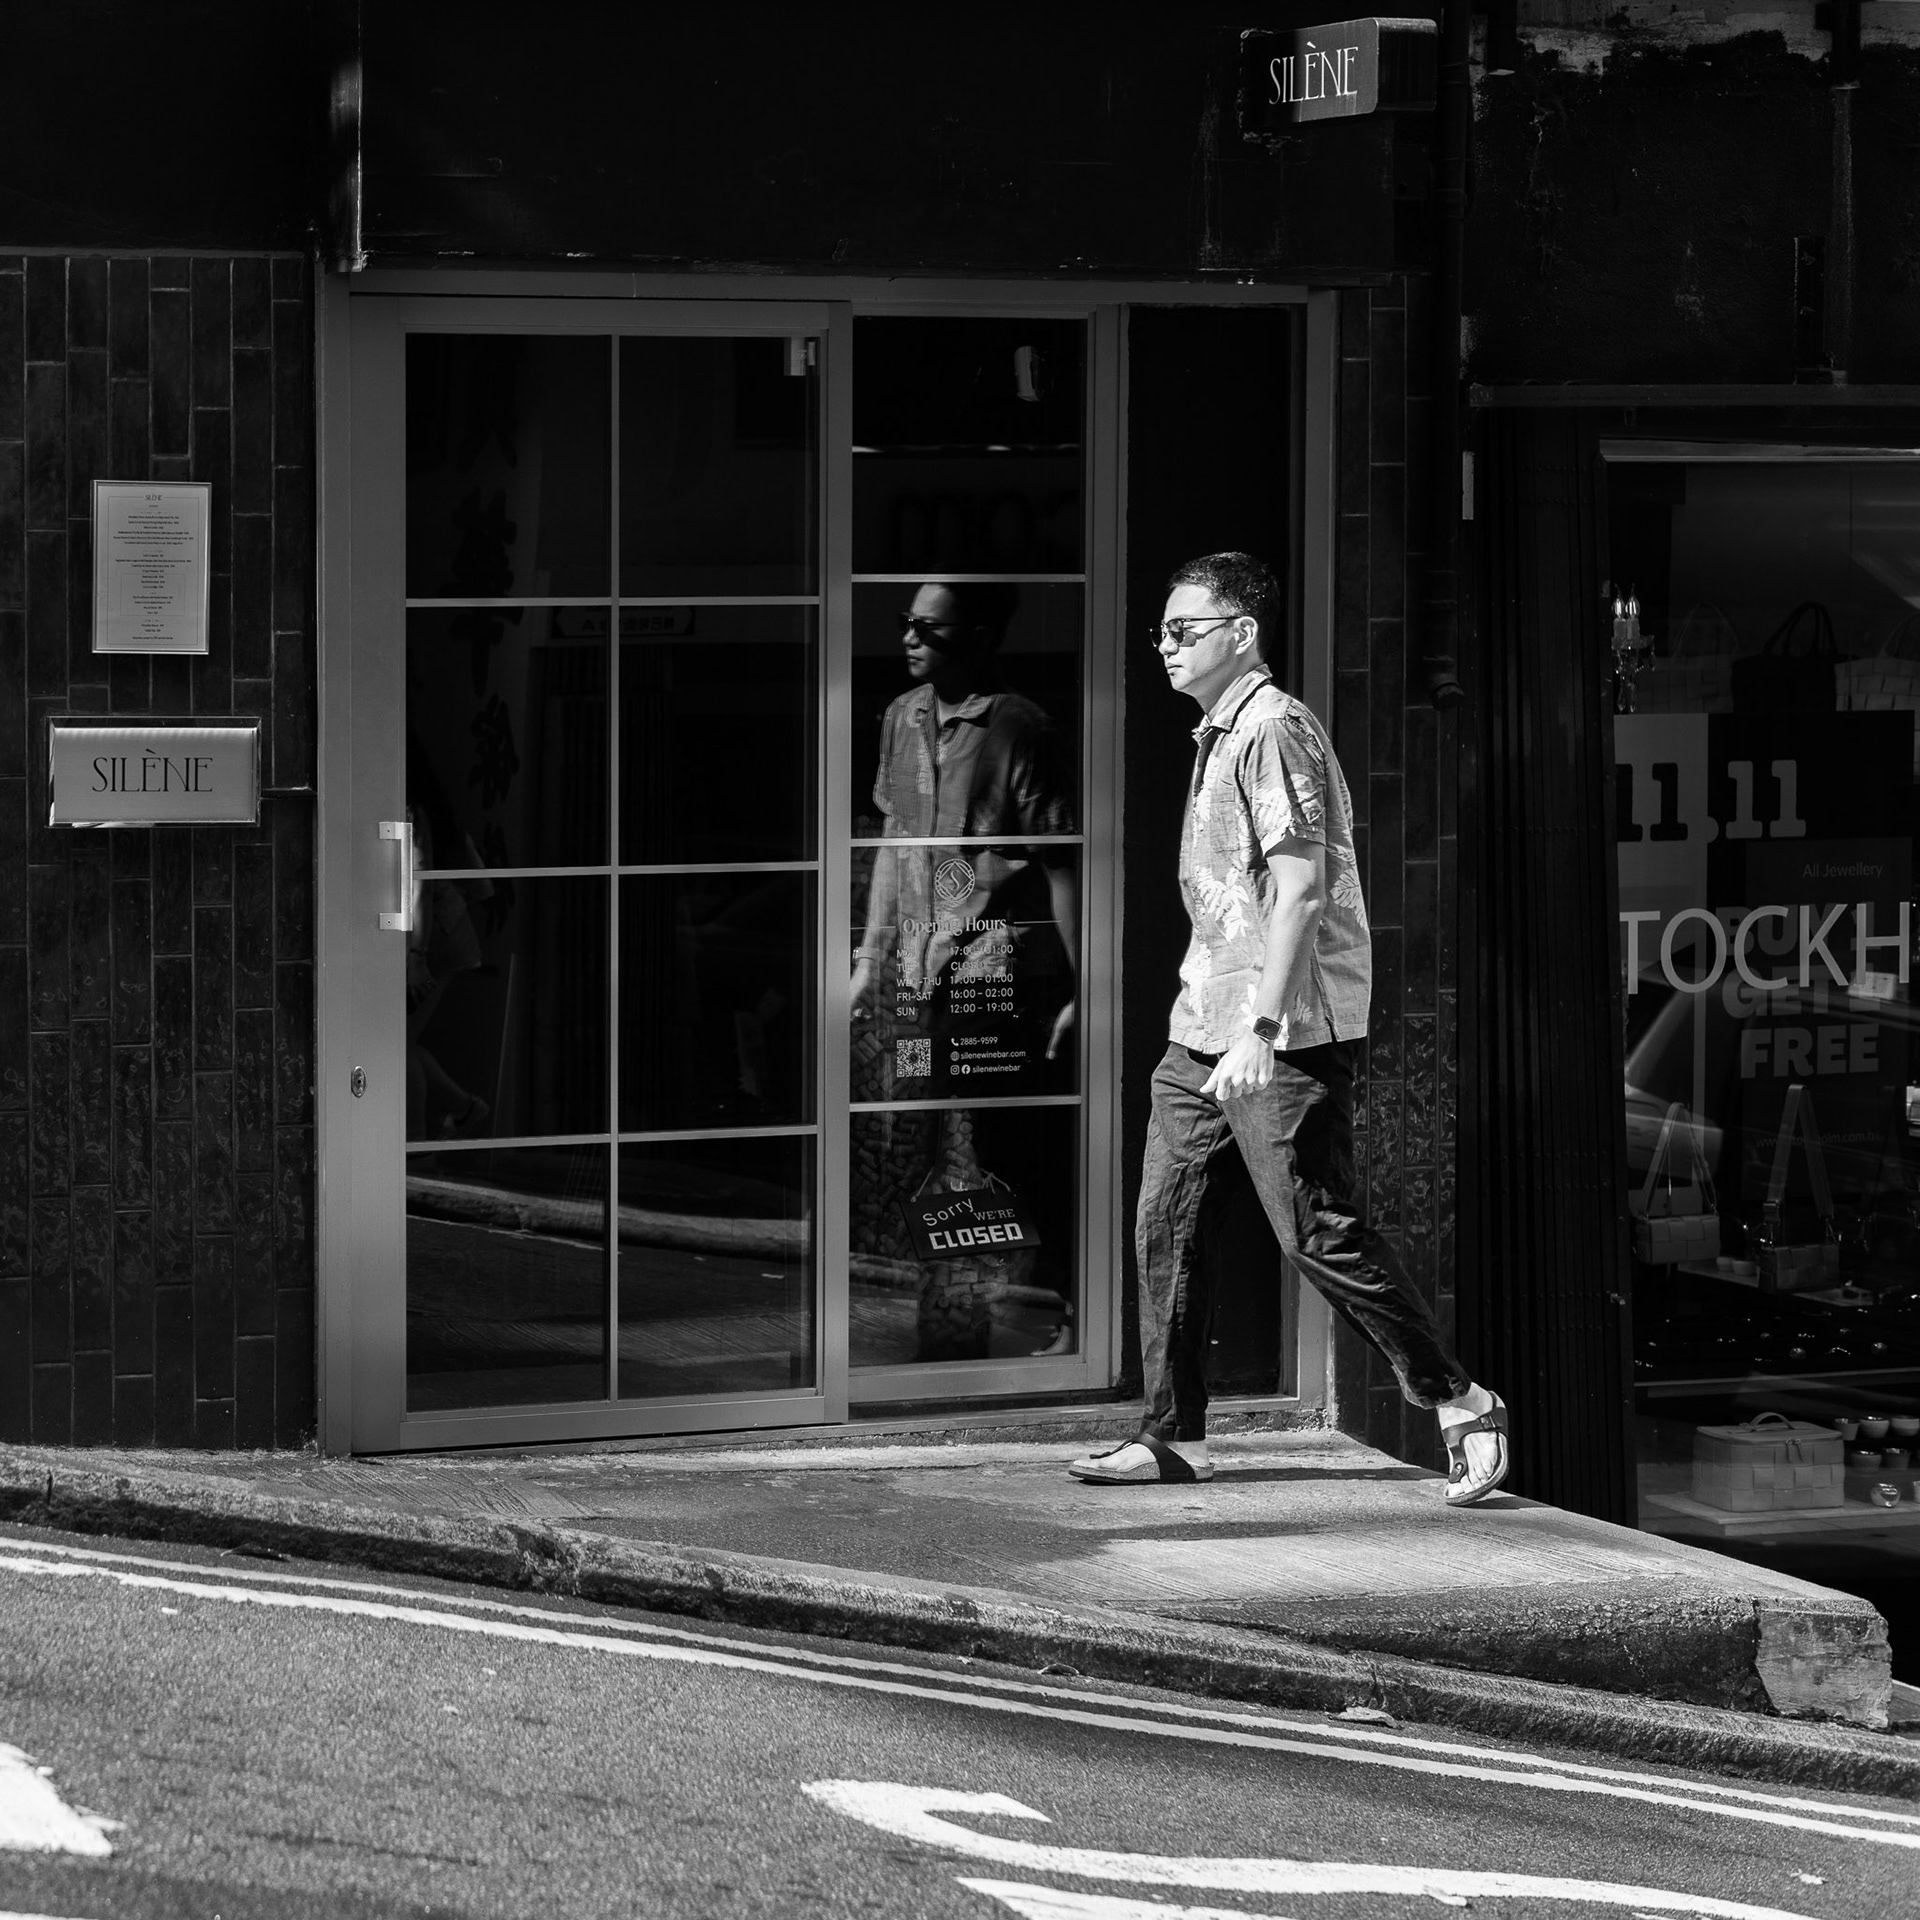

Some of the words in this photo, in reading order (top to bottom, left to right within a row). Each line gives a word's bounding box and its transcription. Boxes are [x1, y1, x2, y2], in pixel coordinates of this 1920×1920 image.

[1268, 41, 1359, 105] SILÈNE
[92, 748, 213, 792] SILÈNE
[1616, 760, 1806, 842] 11.11
[1802, 863, 1820, 878] All
[1822, 861, 1883, 879] Jewellery
[903, 918, 963, 936] Opening
[965, 916, 1007, 932] Hours
[950, 989, 976, 999] 16:00
[985, 987, 1014, 998] 02:00
[896, 1006, 915, 1017] SUN
[950, 1003, 976, 1014] 12:00
[986, 1002, 1014, 1012] 19:00
[960, 1036, 998, 1045] 2885-9599
[960, 1050, 1026, 1060] silenewinebar.com
[1740, 1023, 1880, 1080] FREE
[972, 1064, 1021, 1073] silenewinebar
[922, 1198, 974, 1227] Sorry
[928, 1222, 1024, 1250] CLOSED
